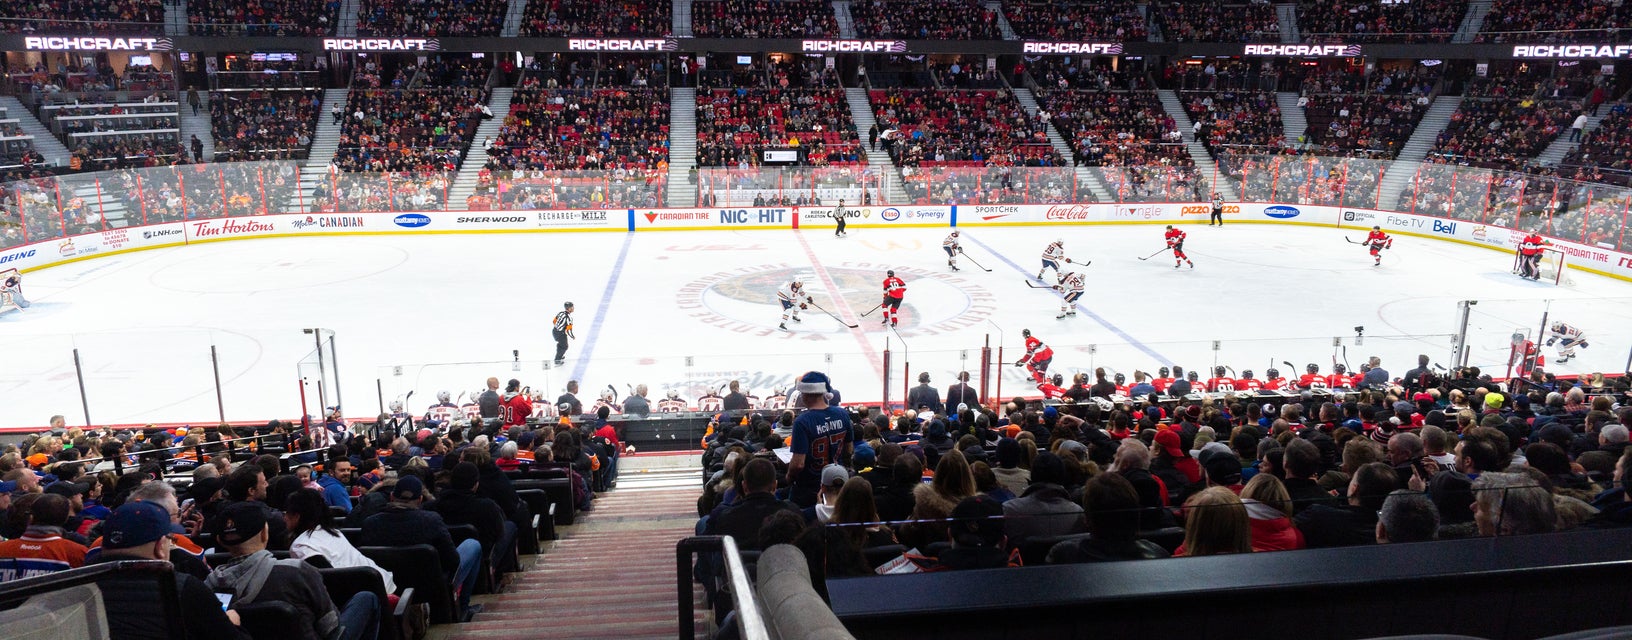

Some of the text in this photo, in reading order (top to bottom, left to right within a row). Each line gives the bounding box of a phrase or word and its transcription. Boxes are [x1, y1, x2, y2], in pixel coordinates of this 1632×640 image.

[25, 36, 157, 51] RICHCRAFT
[323, 38, 427, 51] RICHCRAFT
[568, 38, 666, 51] RICHCRAFT
[802, 40, 895, 52] RICHCRAFT
[1023, 42, 1112, 54] RICHCRAFT
[1244, 44, 1348, 57] RICHCRAFT
[1512, 45, 1632, 58] RICHCRAF
[538, 212, 574, 220] RECHARGE
[581, 211, 607, 220] MILK
[659, 212, 710, 221] CANADIAN TIRE
[758, 209, 786, 223] HIT
[826, 210, 861, 218] CNO
[916, 210, 945, 219] Synergy
[1181, 206, 1210, 216] pizza
[319, 216, 363, 228] CANADIAN
[457, 216, 526, 224] SHER-WOOD
[1387, 216, 1425, 228] Fibe TV
[193, 219, 274, 237] Tim Hortons
[1433, 220, 1457, 235] Bell
[0, 249, 36, 264] OEING
[1592, 251, 1609, 262] TIRE
[816, 419, 844, 435] McDAVID
[811, 430, 848, 471] 97
